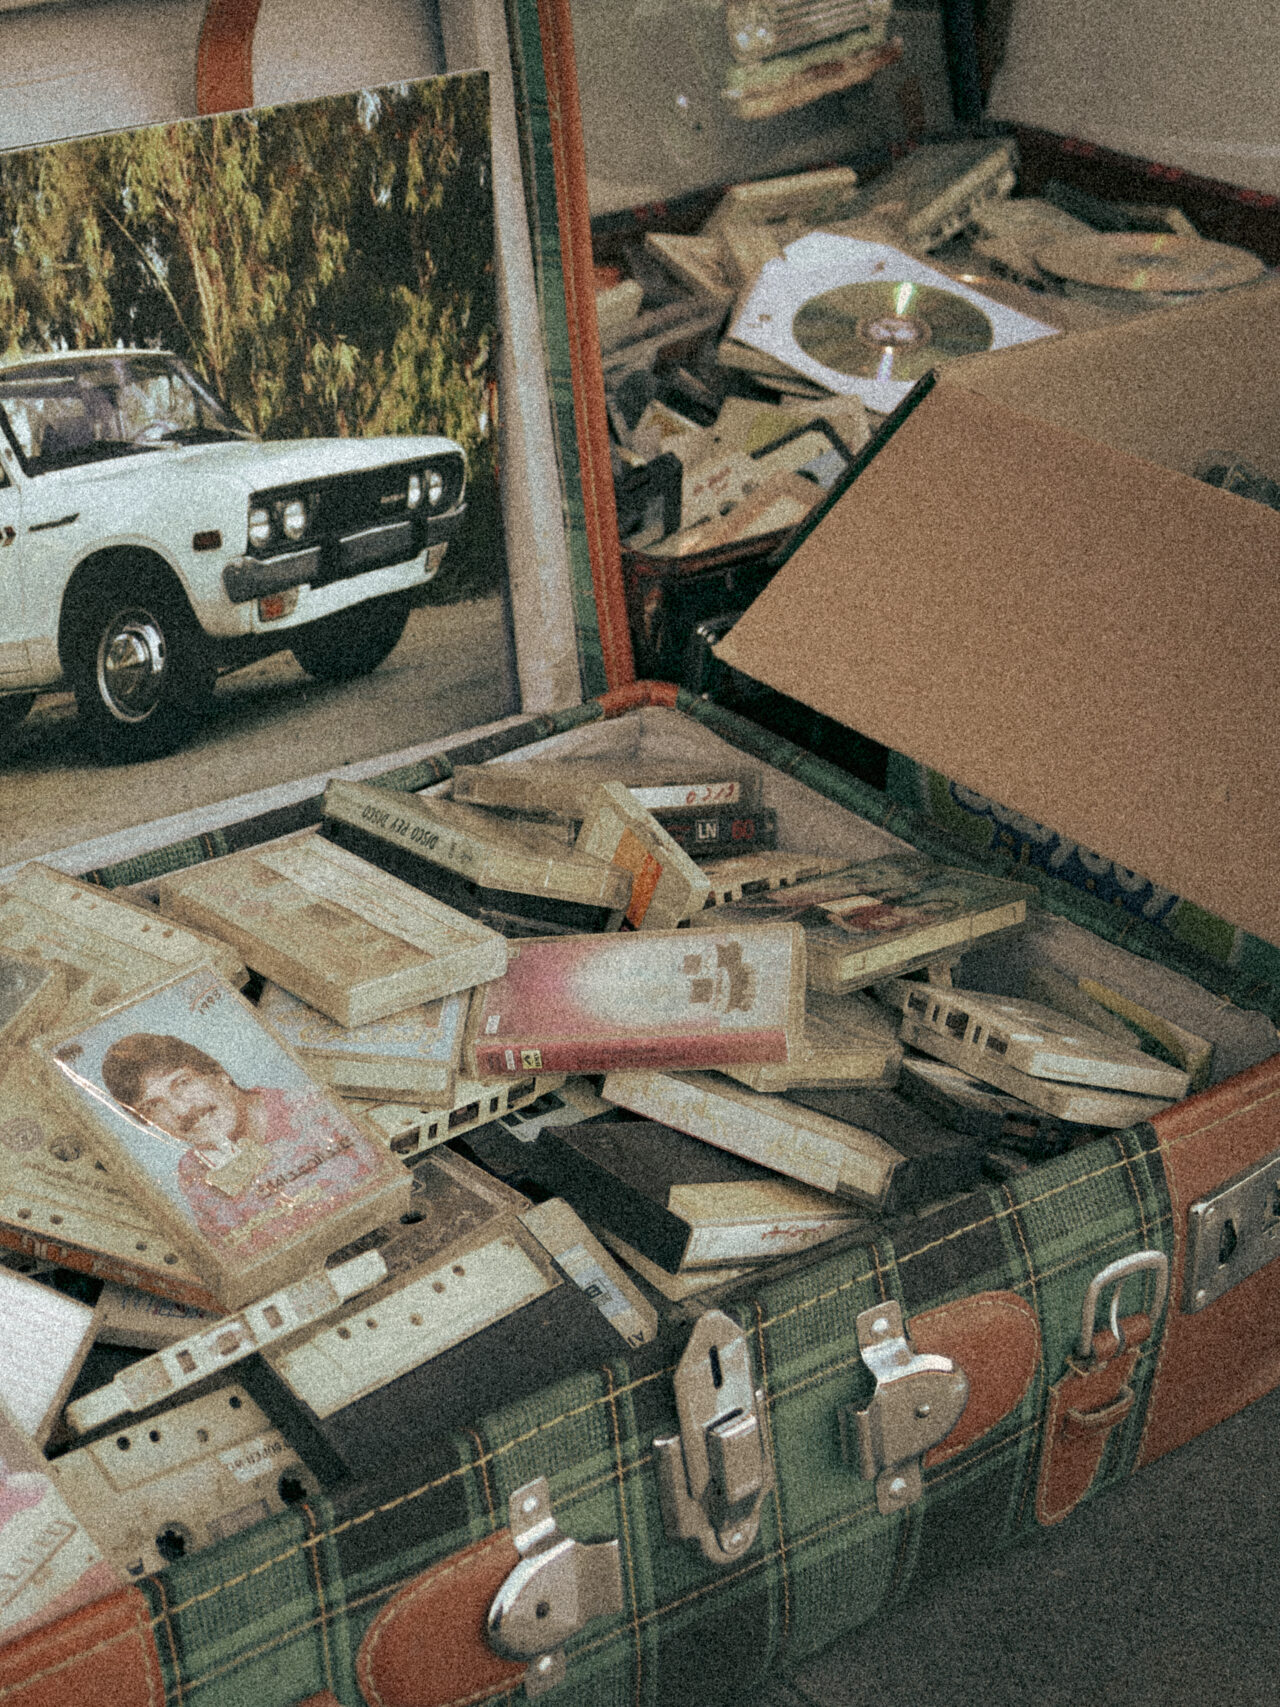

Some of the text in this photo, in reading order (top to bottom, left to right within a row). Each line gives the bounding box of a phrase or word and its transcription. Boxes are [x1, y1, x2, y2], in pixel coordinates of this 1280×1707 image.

[361, 804, 390, 828] DISCO
[410, 826, 439, 850] DISCO
[698, 822, 717, 840] LN
[731, 819, 756, 840] 60
